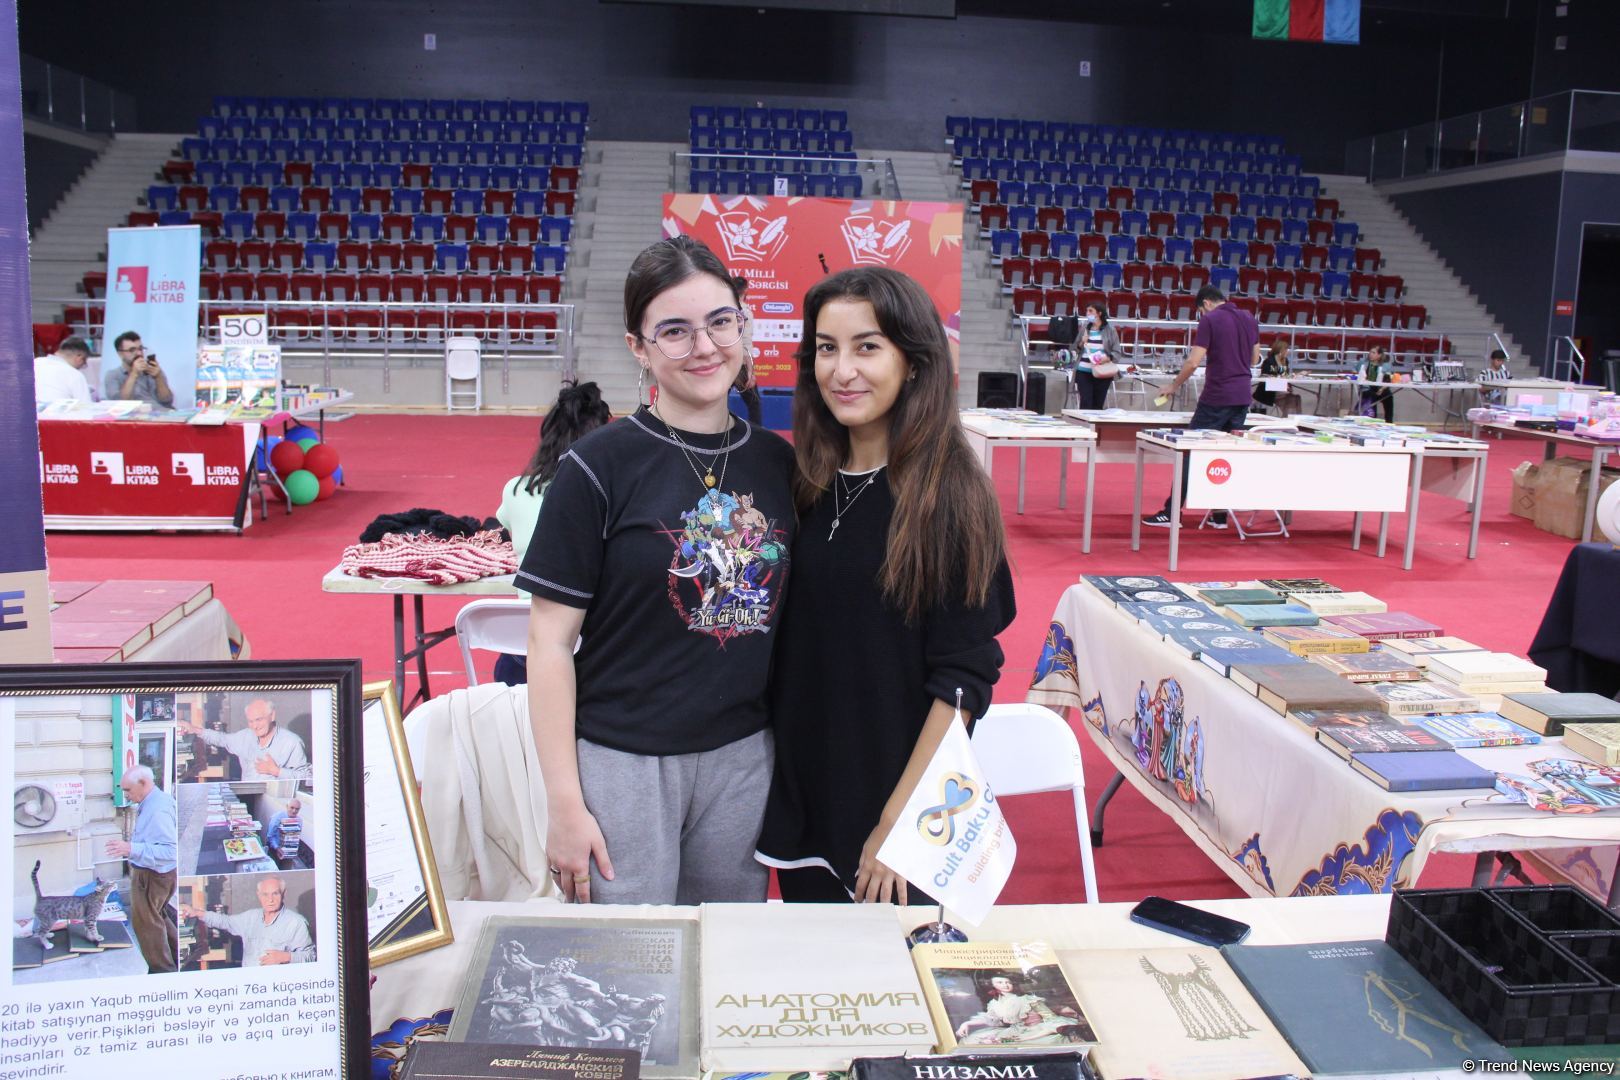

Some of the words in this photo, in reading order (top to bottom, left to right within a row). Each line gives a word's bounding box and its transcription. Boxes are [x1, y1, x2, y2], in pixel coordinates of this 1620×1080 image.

[777, 179, 785, 190] 7
[224, 318, 263, 338] 50
[1209, 467, 1229, 476] 40%
[697, 607, 761, 626] Yu-Gi-Oh!
[934, 852, 963, 888] Cult
[956, 807, 991, 853] Baku
[968, 838, 1001, 884] Building
[2, 1004, 19, 1016] 20
[27, 1003, 42, 1014] ilə
[48, 1000, 84, 1014] yaxın
[91, 994, 132, 1008] Yaqub
[138, 989, 188, 1003] müəllim
[194, 986, 238, 1001] Xəqani
[244, 984, 267, 995] 76a
[273, 979, 335, 993] küçəsində
[715, 992, 920, 1008] АНАТОМИЯ
[1, 1018, 35, 1032] kitab
[41, 1012, 111, 1028] satışıynan
[118, 1005, 181, 1021] məşguldu
[187, 1005, 202, 1015] və
[207, 1002, 234, 1015] eyni
[240, 996, 297, 1010] zamanda
[302, 993, 335, 1005] kitabı
[778, 1007, 860, 1023] ДЛЯ
[1, 1034, 58, 1048] hədiyyə
[164, 1018, 216, 1033] bəsləyir
[224, 1017, 239, 1027] və
[247, 1012, 290, 1027] yoldan
[298, 1009, 336, 1022] keçən
[717, 1022, 928, 1038] ХУДОЖНИКОВ
[1, 1049, 64, 1065] insanları
[74, 1046, 90, 1056] öz
[100, 1041, 137, 1053] təmiz
[146, 1036, 188, 1050] aurası
[198, 1034, 213, 1044] ilə
[222, 1032, 237, 1042] və
[246, 1029, 273, 1042] açıq
[282, 1025, 313, 1037] ürəyi
[322, 1023, 336, 1033] ilə
[0, 1063, 67, 1080] sevindirir.
[489, 1058, 623, 1073] АЗЕРБАЙДЖАНСКИЙ
[912, 1065, 1038, 1079] НИЗАМИ
[291, 1068, 337, 1080] книгам,
[574, 1070, 623, 1080] КОВЕР
